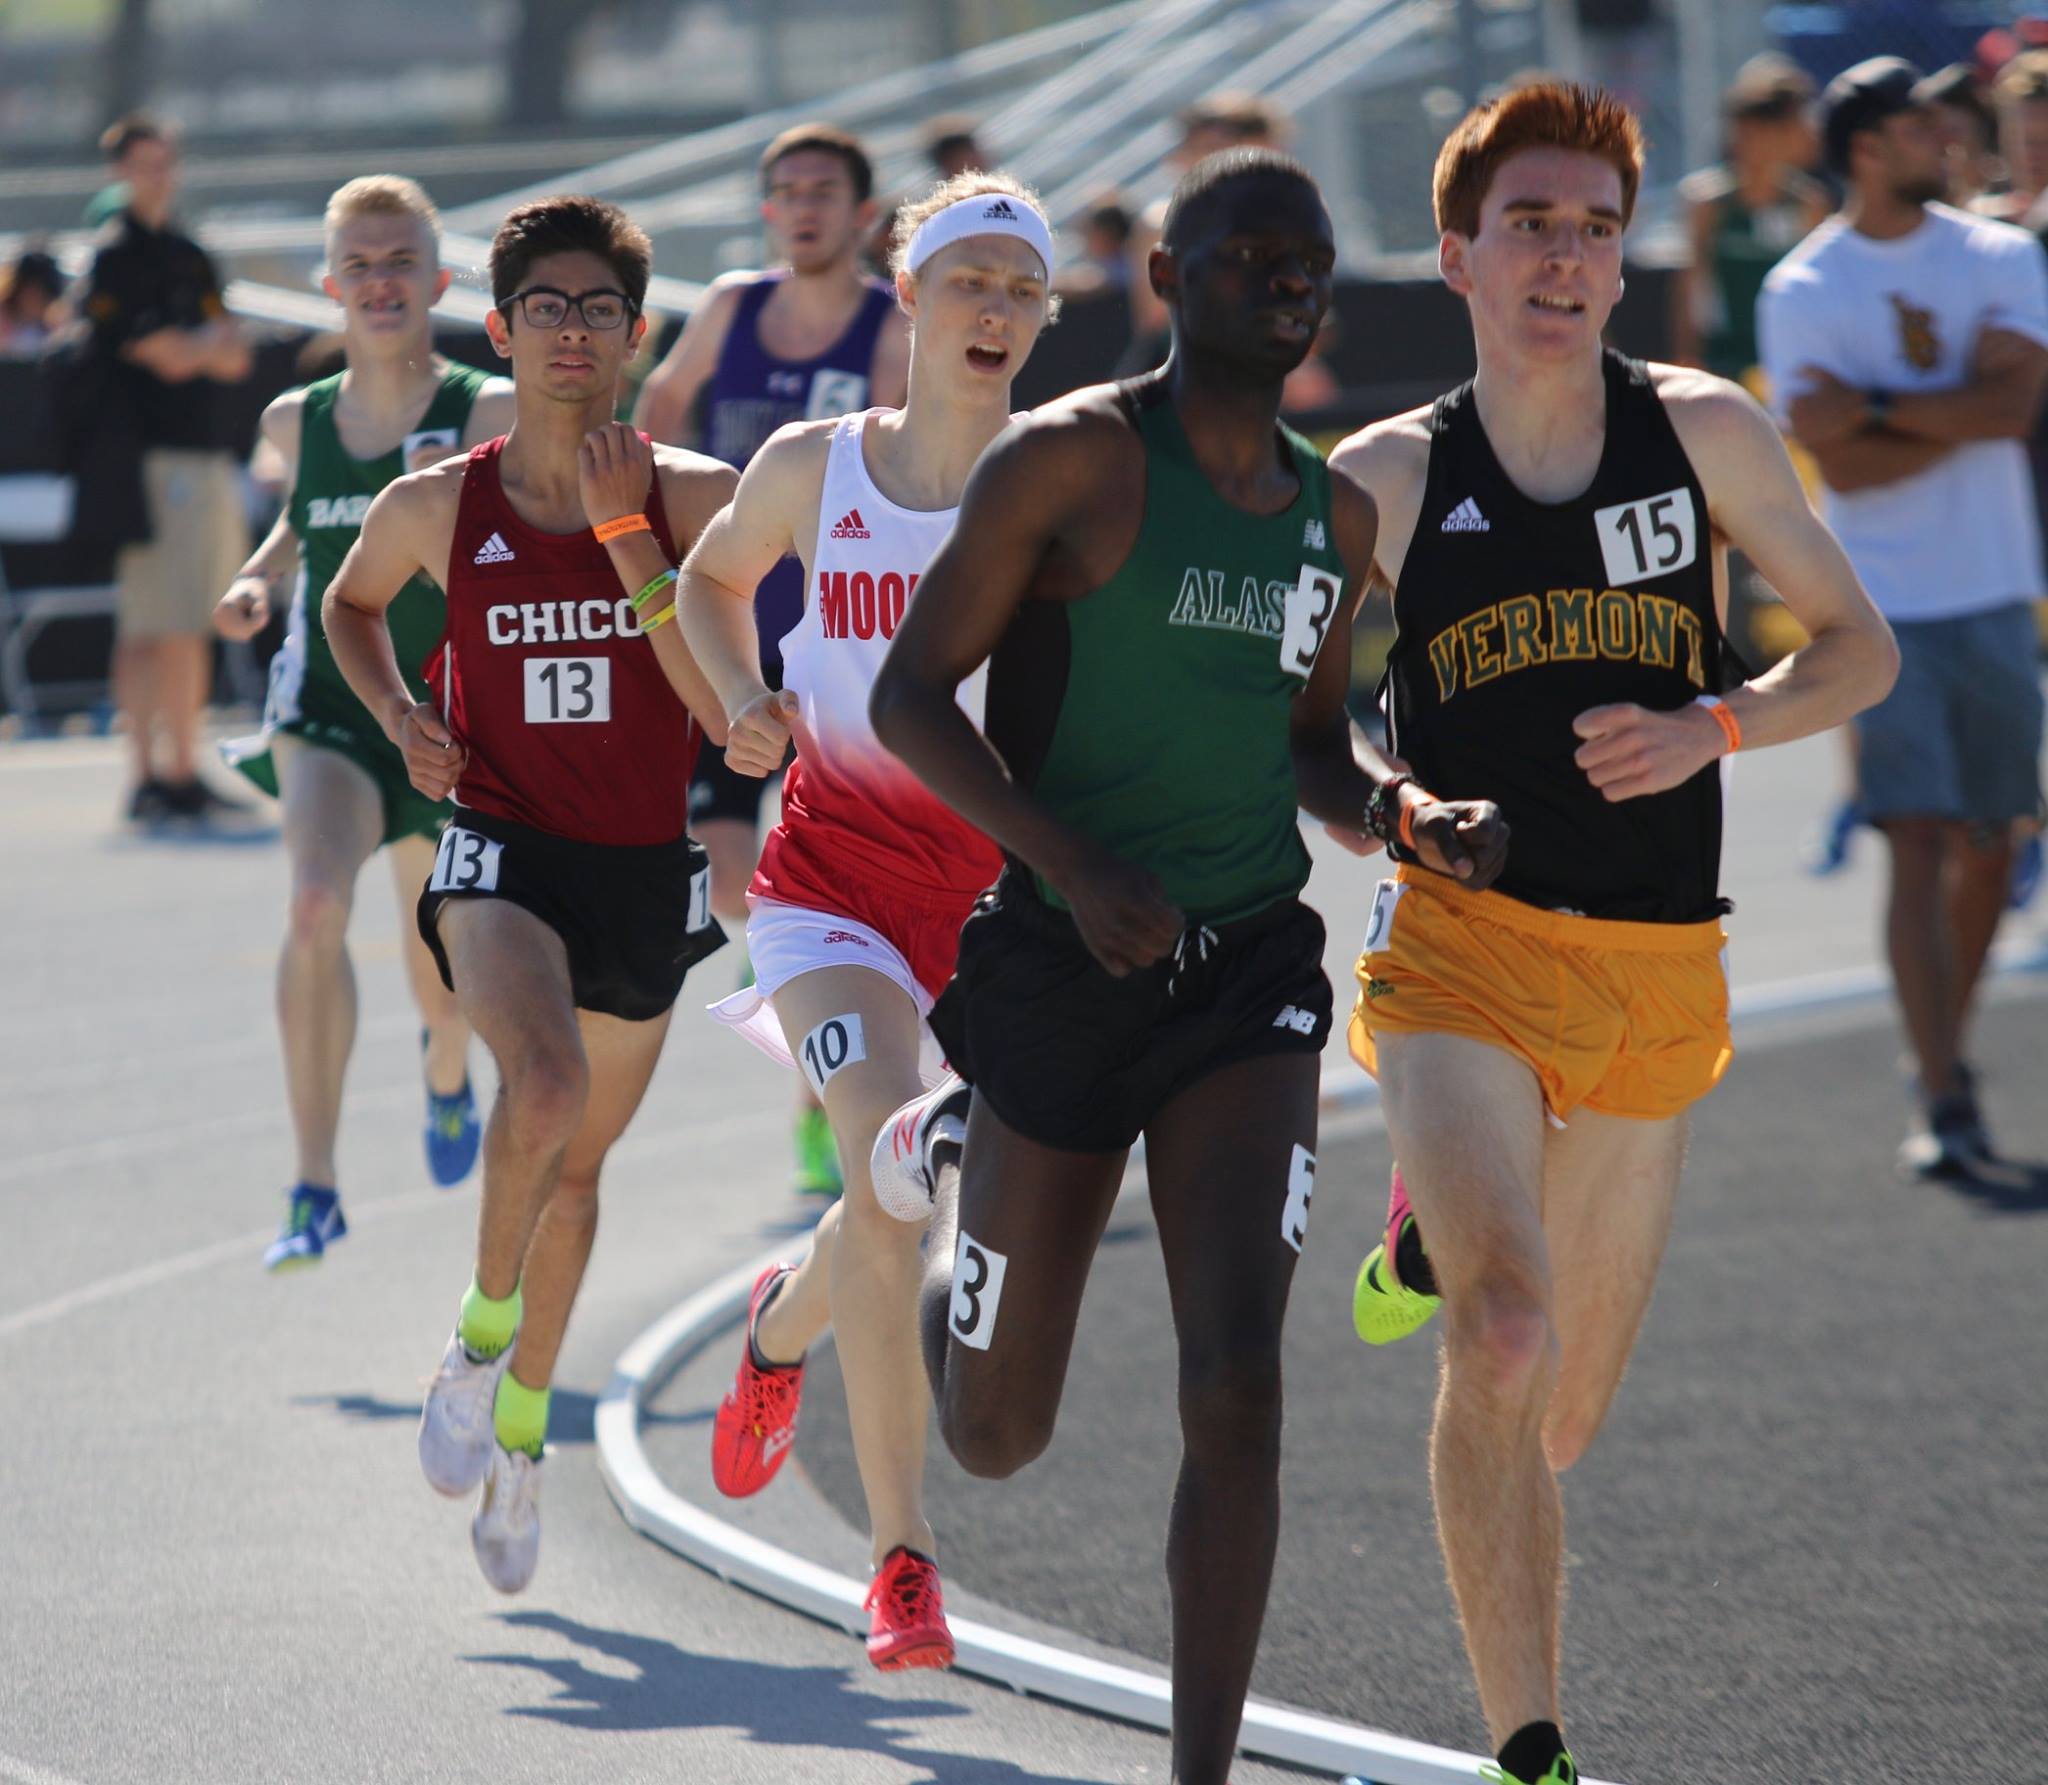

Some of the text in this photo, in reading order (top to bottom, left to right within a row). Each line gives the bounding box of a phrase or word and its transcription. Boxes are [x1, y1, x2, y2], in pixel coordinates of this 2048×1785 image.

[831, 528, 871, 539] adidas
[1441, 518, 1490, 532] adidas
[1615, 497, 1683, 574] 15
[474, 550, 515, 565] adidas
[486, 598, 645, 646] CHICO
[819, 570, 920, 641] MOO
[1168, 567, 1298, 640] ALAS
[1295, 576, 1335, 668] 3
[1428, 588, 1705, 703] VERMONT
[538, 661, 594, 719] 13
[445, 832, 488, 886] 13
[823, 931, 869, 947] adidas
[805, 1020, 848, 1085] 10
[954, 1245, 988, 1336] 3
